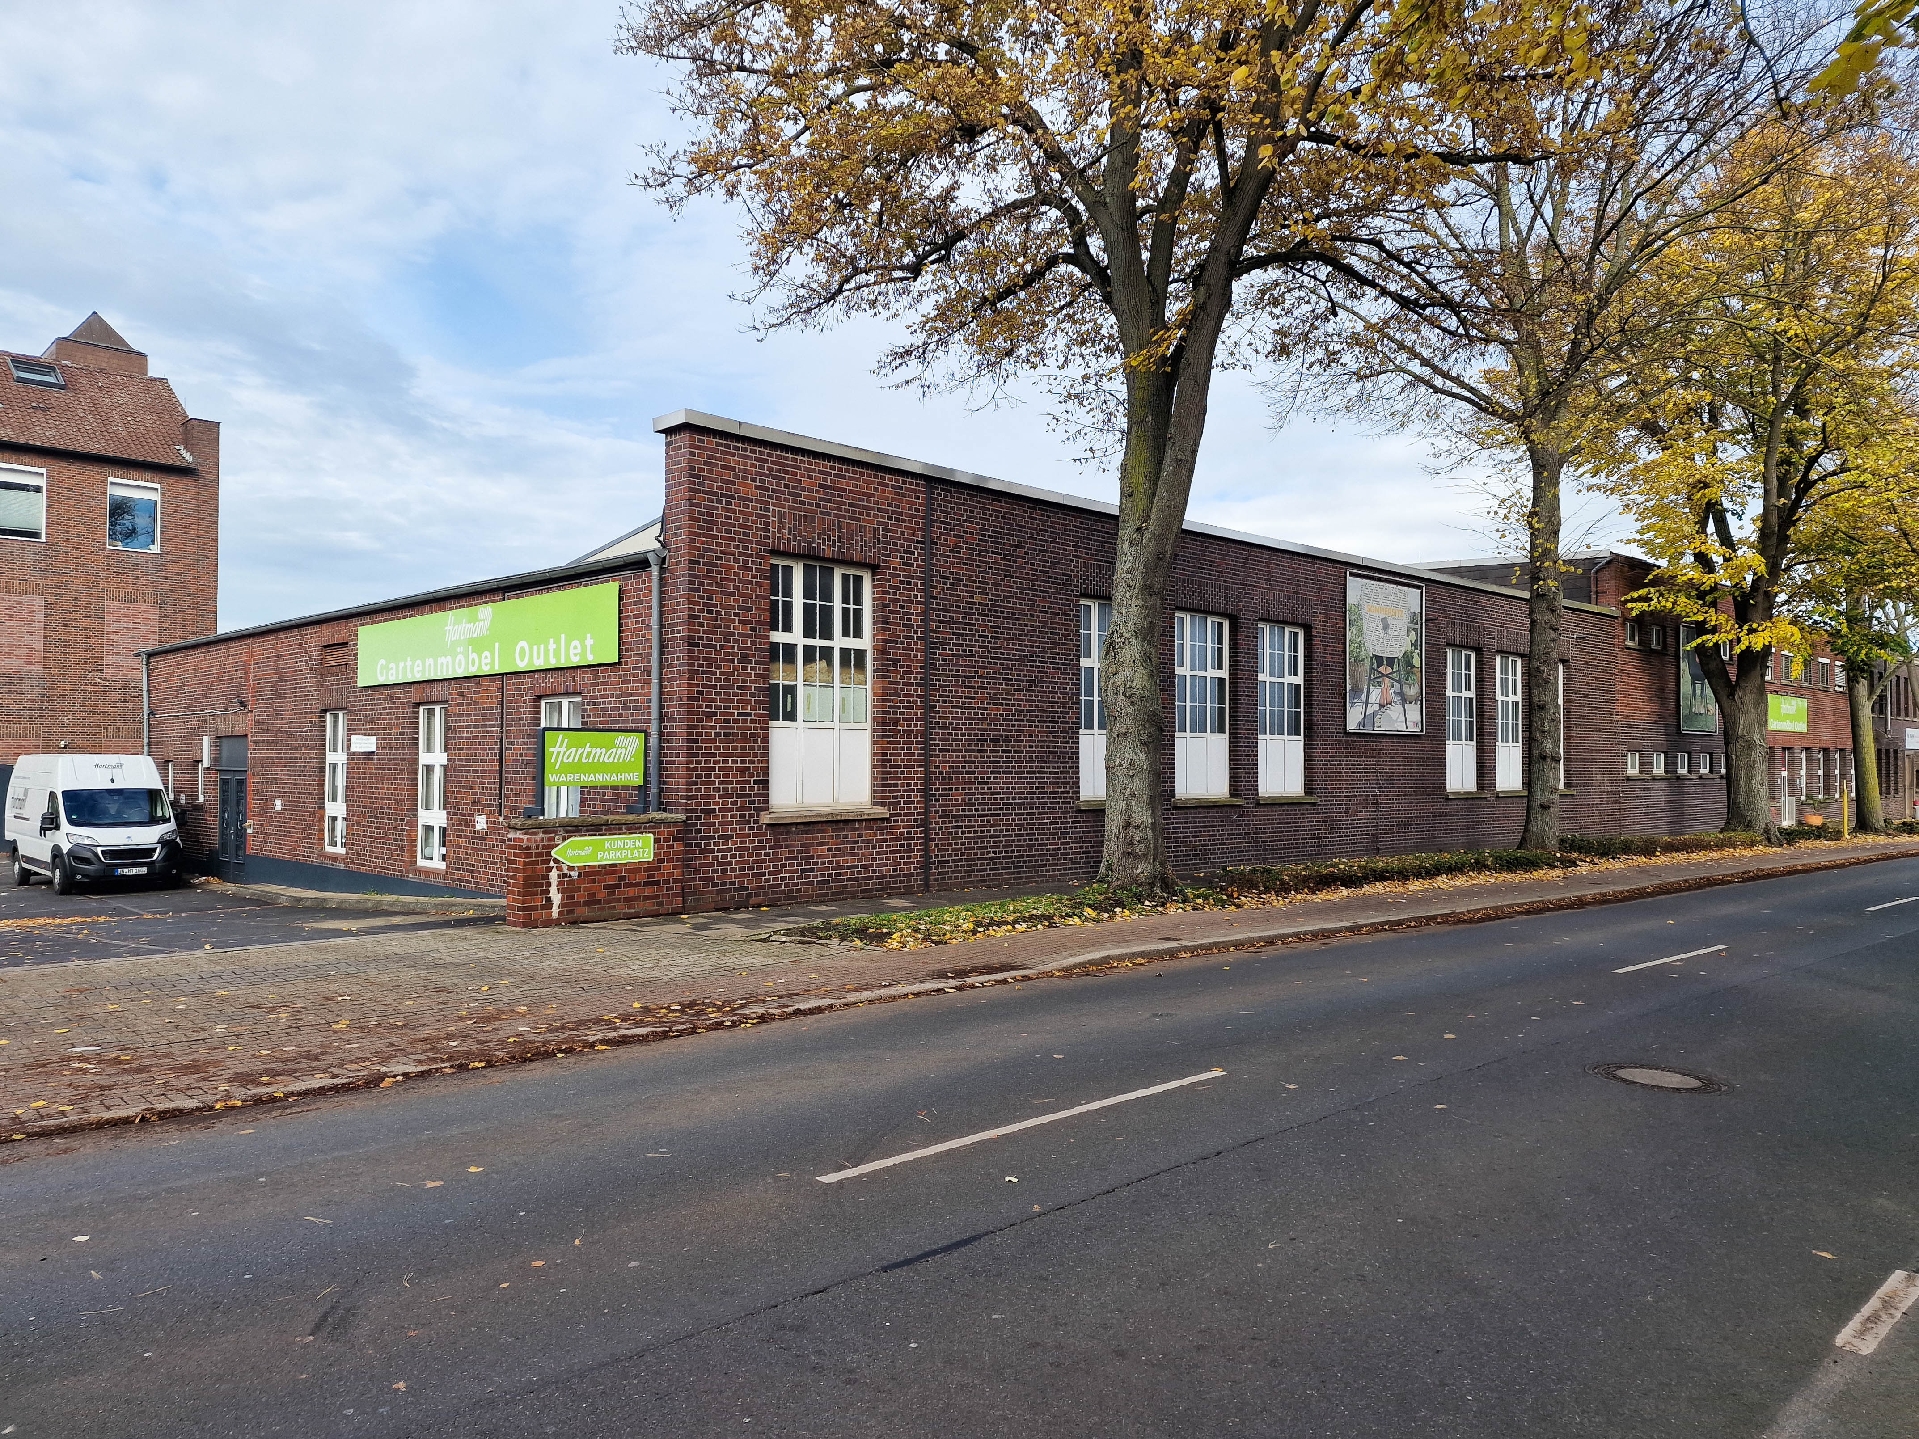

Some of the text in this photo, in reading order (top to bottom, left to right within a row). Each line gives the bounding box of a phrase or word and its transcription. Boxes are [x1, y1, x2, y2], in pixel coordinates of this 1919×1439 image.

[376, 633, 594, 682] Gartenmöbel Outlet
[548, 772, 639, 782] WARENANNAHME
[604, 839, 643, 849] KUNDEN
[597, 848, 649, 860] PARKPLATZ
